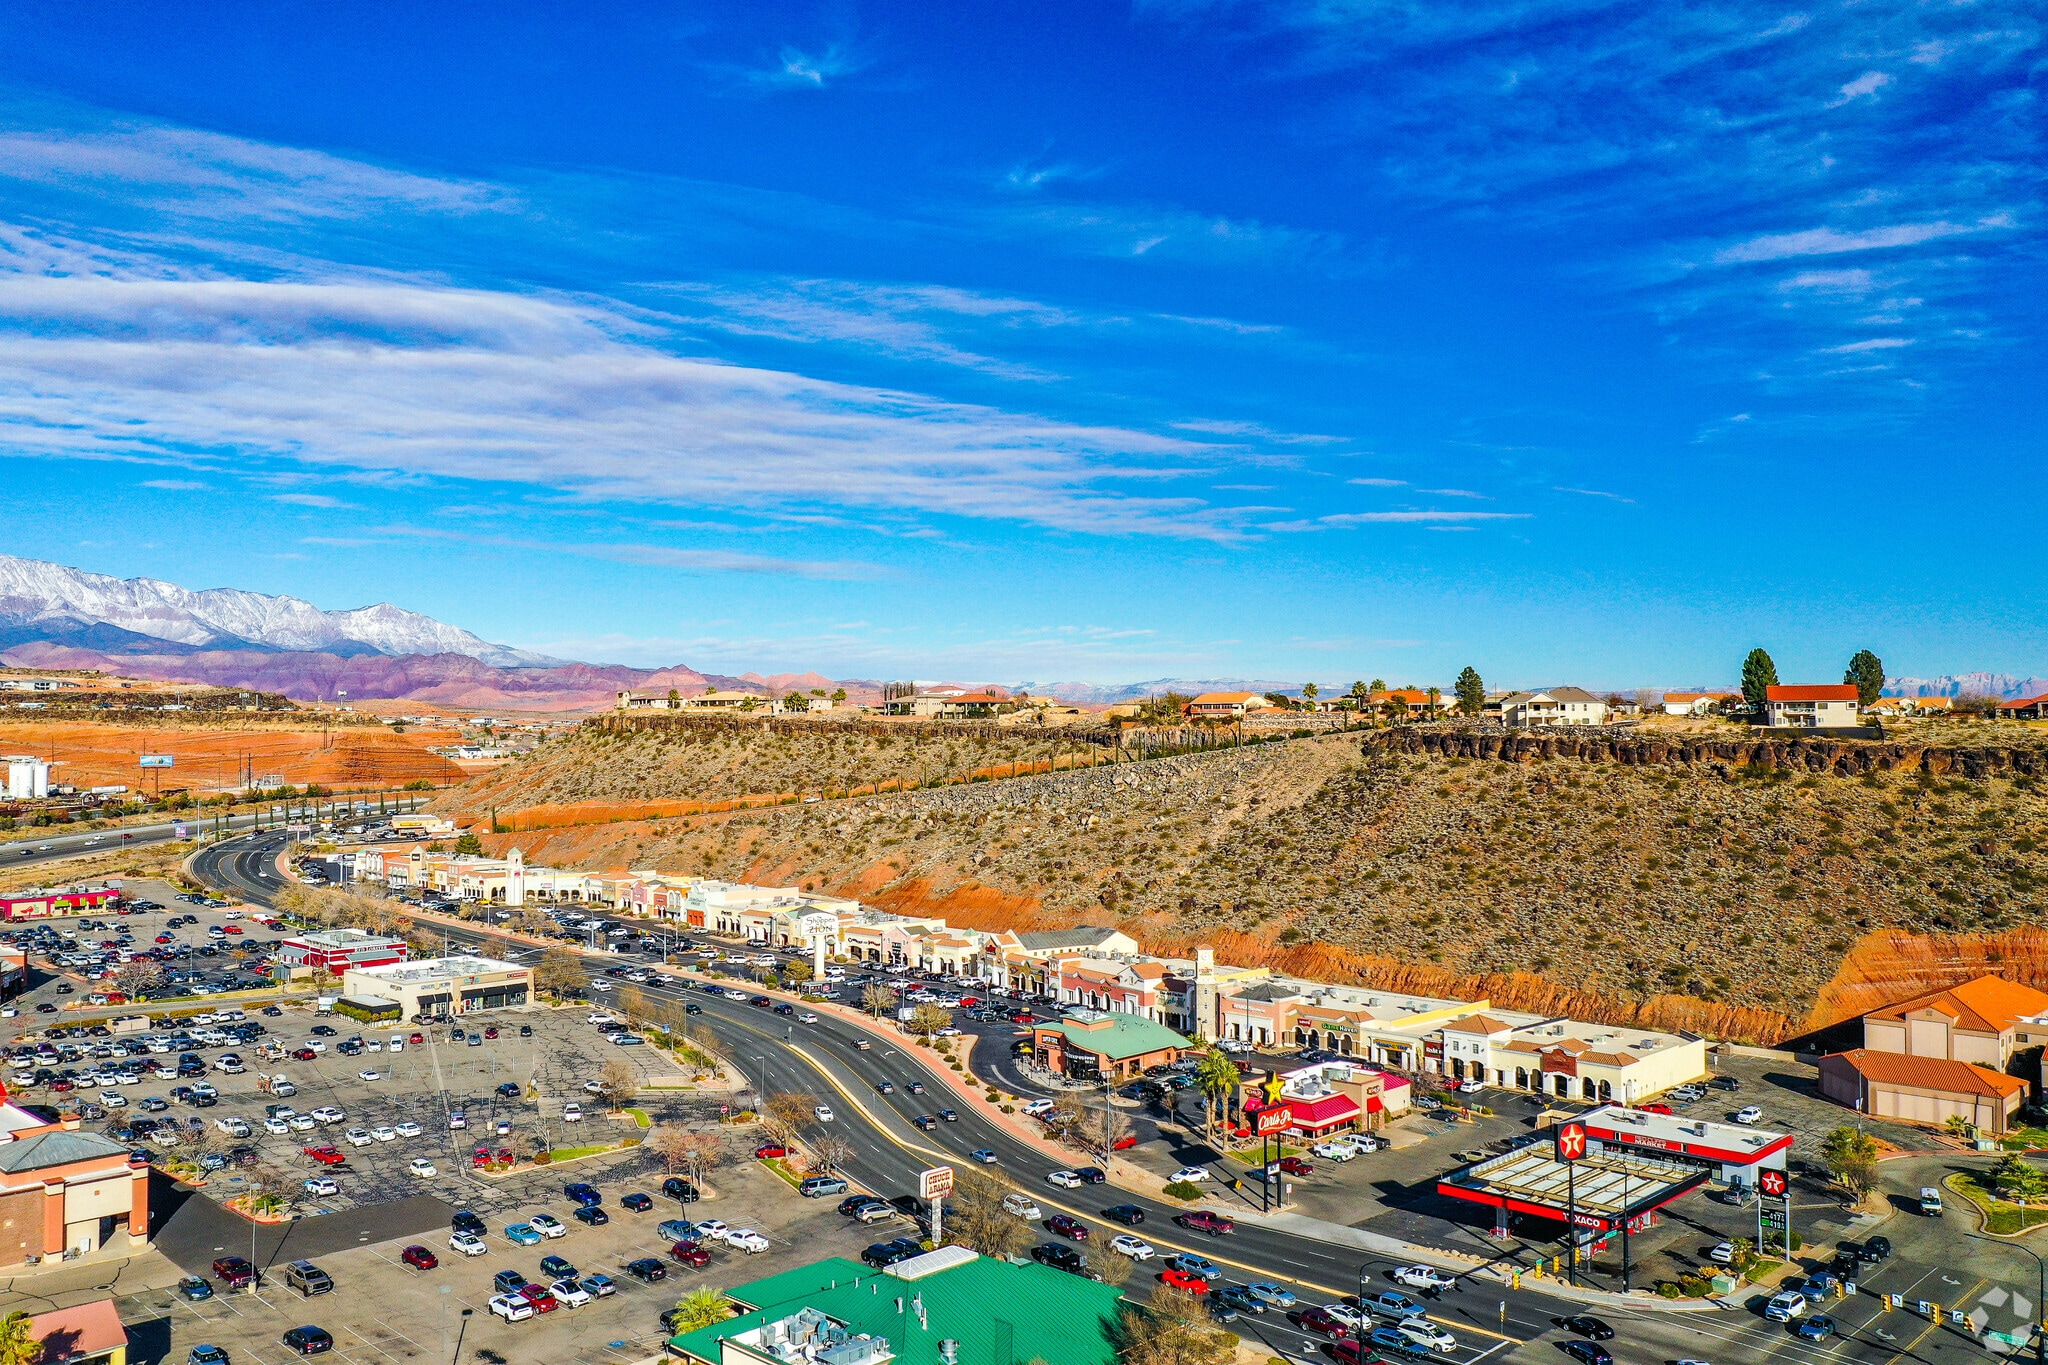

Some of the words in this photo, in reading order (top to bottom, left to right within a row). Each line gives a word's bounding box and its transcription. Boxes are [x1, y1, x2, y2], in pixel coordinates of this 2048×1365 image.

[805, 916, 835, 926] Shoppes
[808, 925, 833, 934] ZION
[1258, 1112, 1281, 1130] Carl's
[1280, 1109, 1293, 1125] Jr.
[1635, 1139, 1667, 1149] MARKET
[929, 1172, 950, 1184] CHUCK
[929, 1181, 951, 1194] ARAMA
[1563, 1212, 1600, 1228] TXACO
